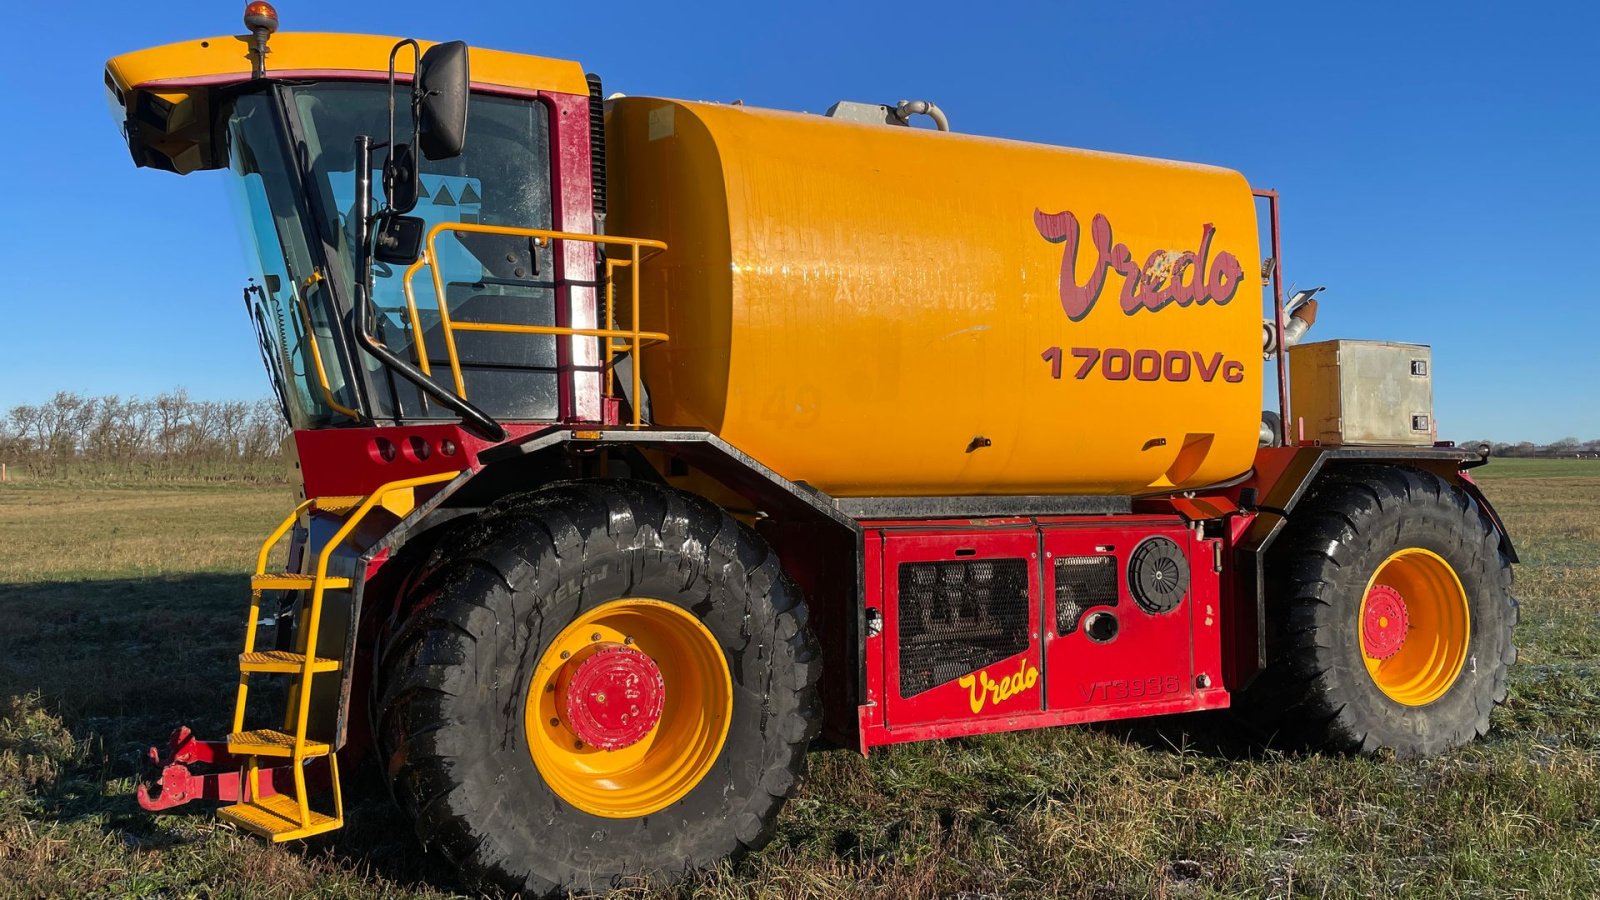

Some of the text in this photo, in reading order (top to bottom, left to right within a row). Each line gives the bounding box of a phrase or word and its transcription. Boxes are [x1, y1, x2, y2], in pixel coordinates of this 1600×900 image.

[1034, 207, 1244, 322] Vredo
[1041, 346, 1244, 383] 17000Vc
[959, 658, 1038, 714] Vredo
[1080, 674, 1181, 703] VT3936
